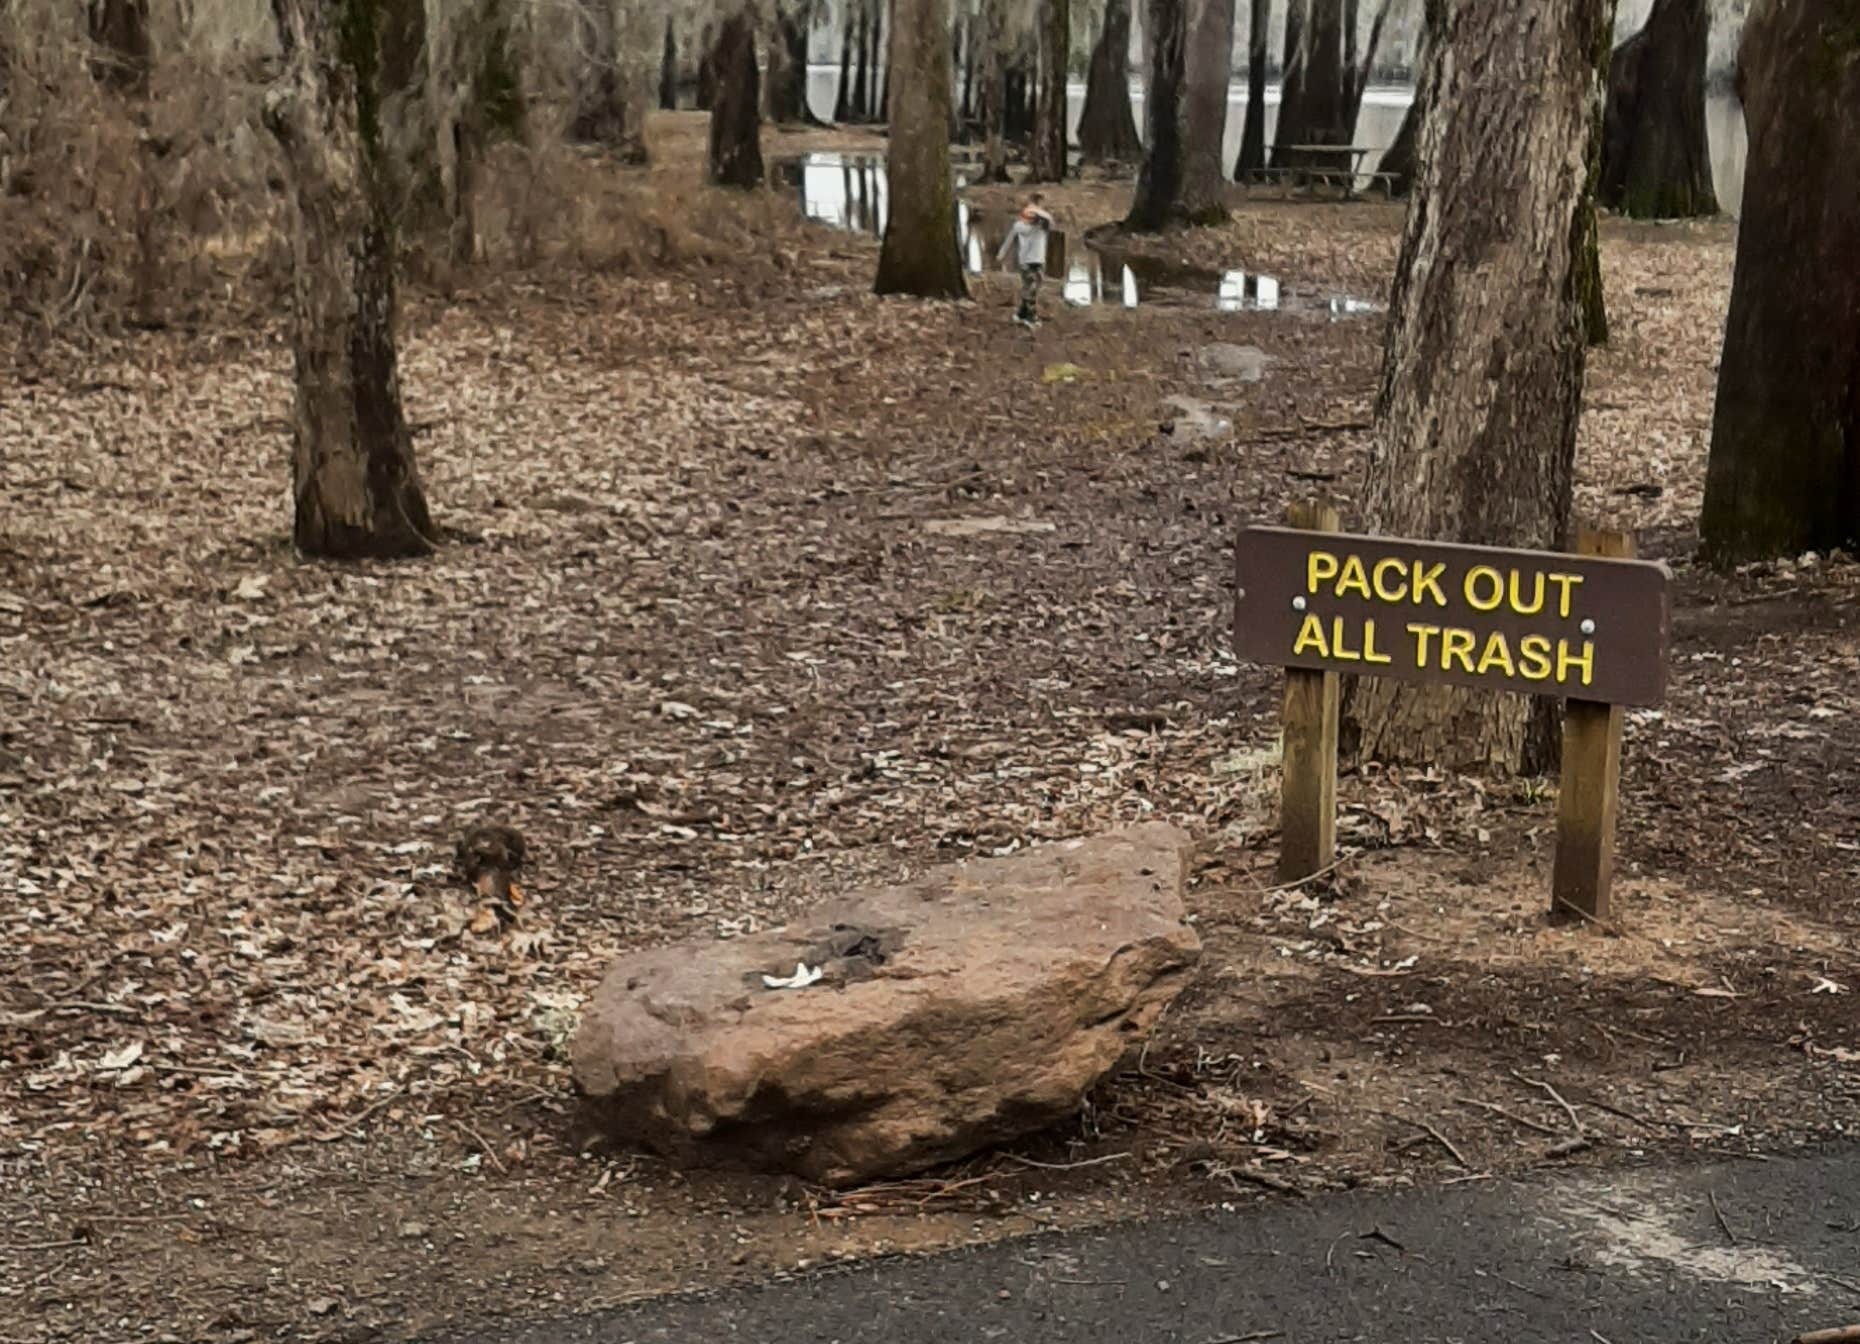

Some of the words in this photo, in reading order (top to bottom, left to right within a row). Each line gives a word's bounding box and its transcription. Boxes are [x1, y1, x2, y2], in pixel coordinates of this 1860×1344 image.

[1306, 551, 1446, 606] PACK
[1462, 564, 1583, 618] OUT
[1292, 613, 1390, 663] ALL
[1406, 624, 1595, 686] TRASH
